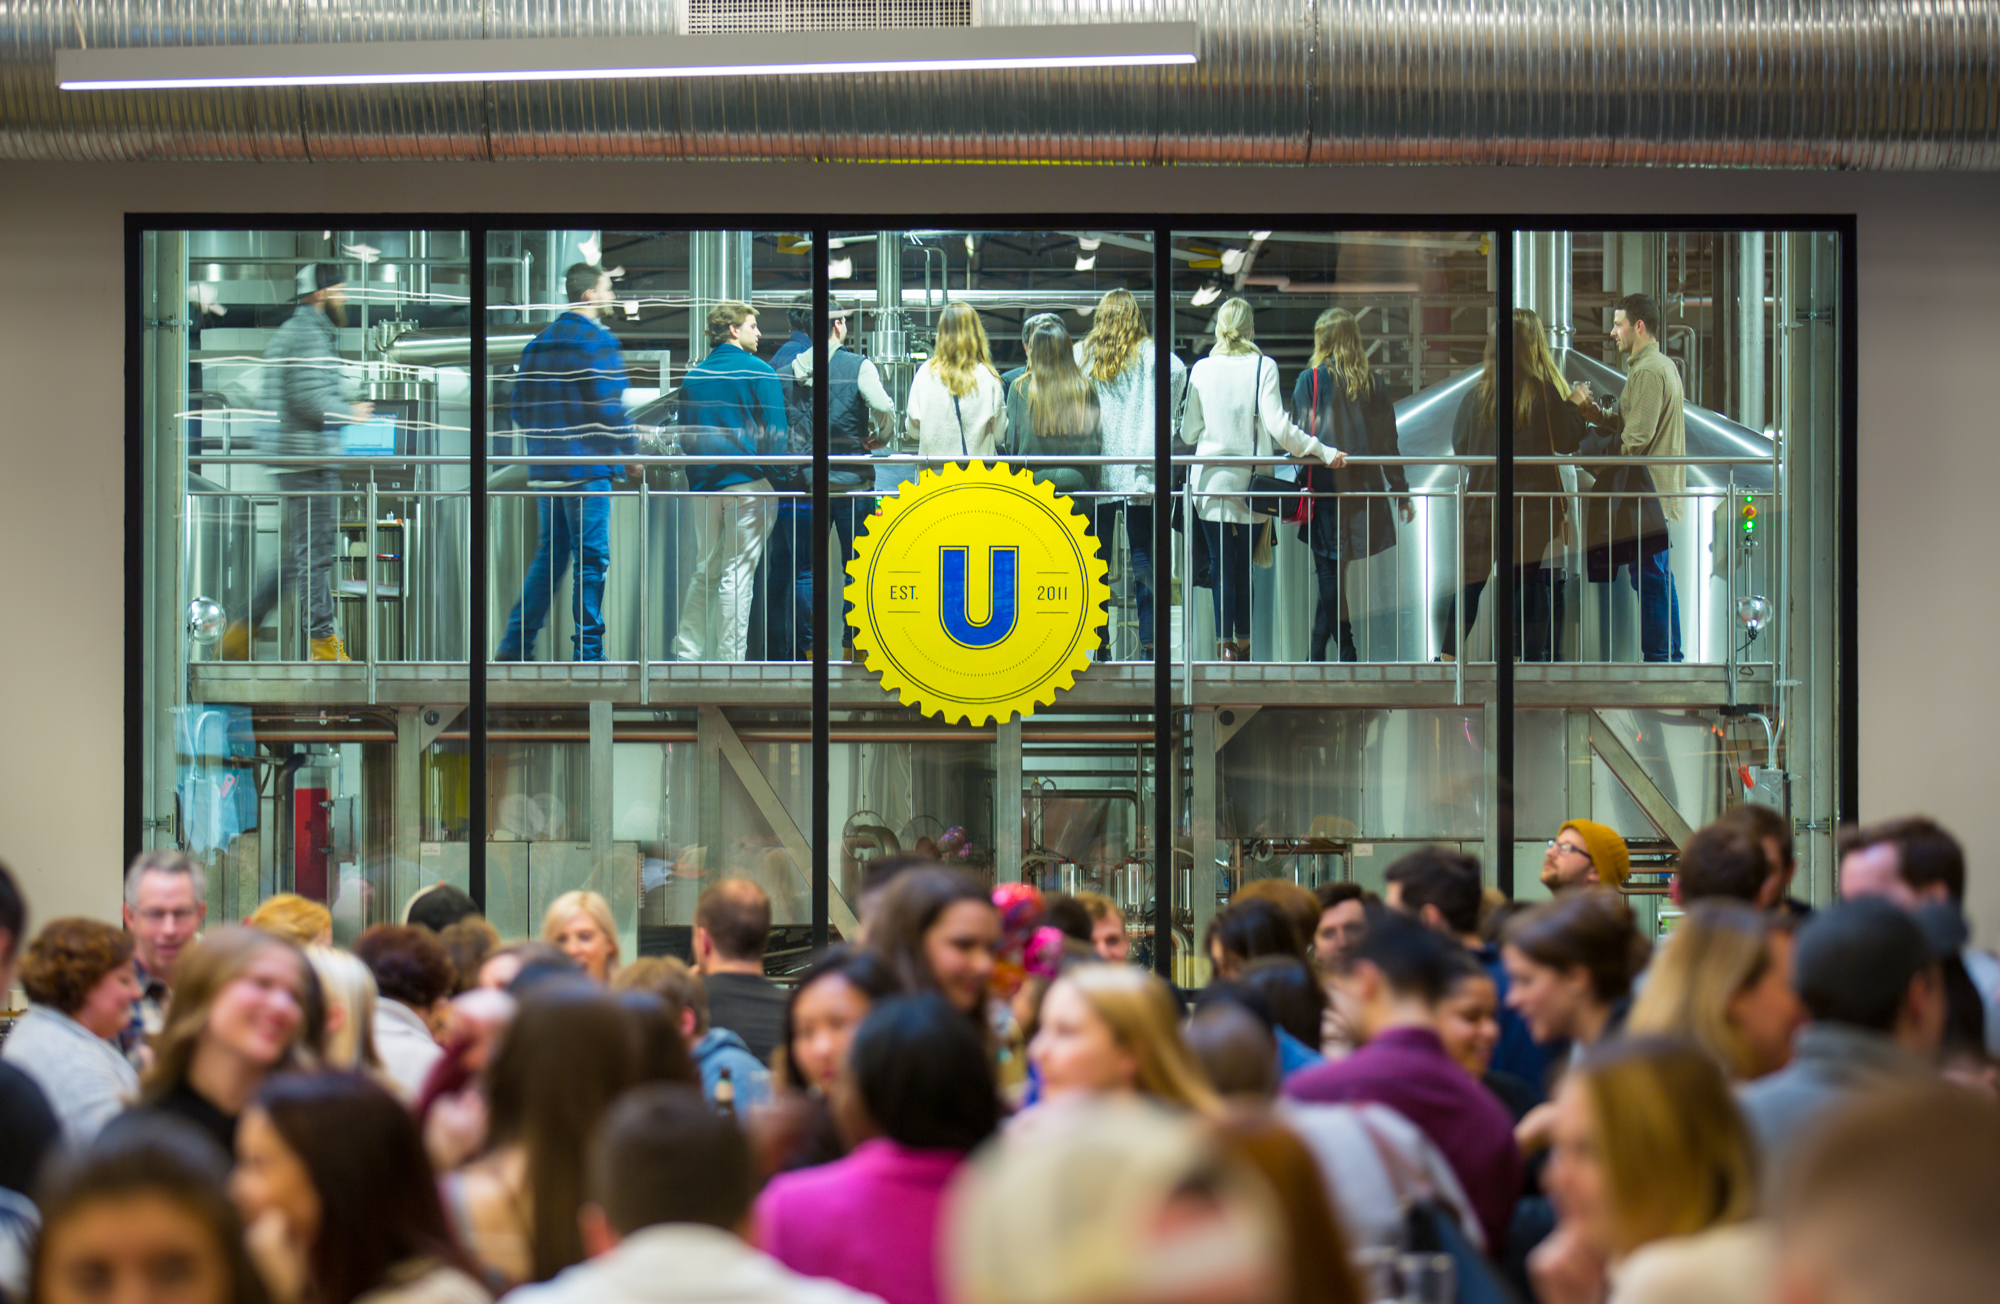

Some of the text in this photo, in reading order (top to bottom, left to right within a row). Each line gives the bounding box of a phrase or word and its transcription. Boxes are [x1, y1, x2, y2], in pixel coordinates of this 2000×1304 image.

[890, 545, 1068, 651] EST. U 2011
